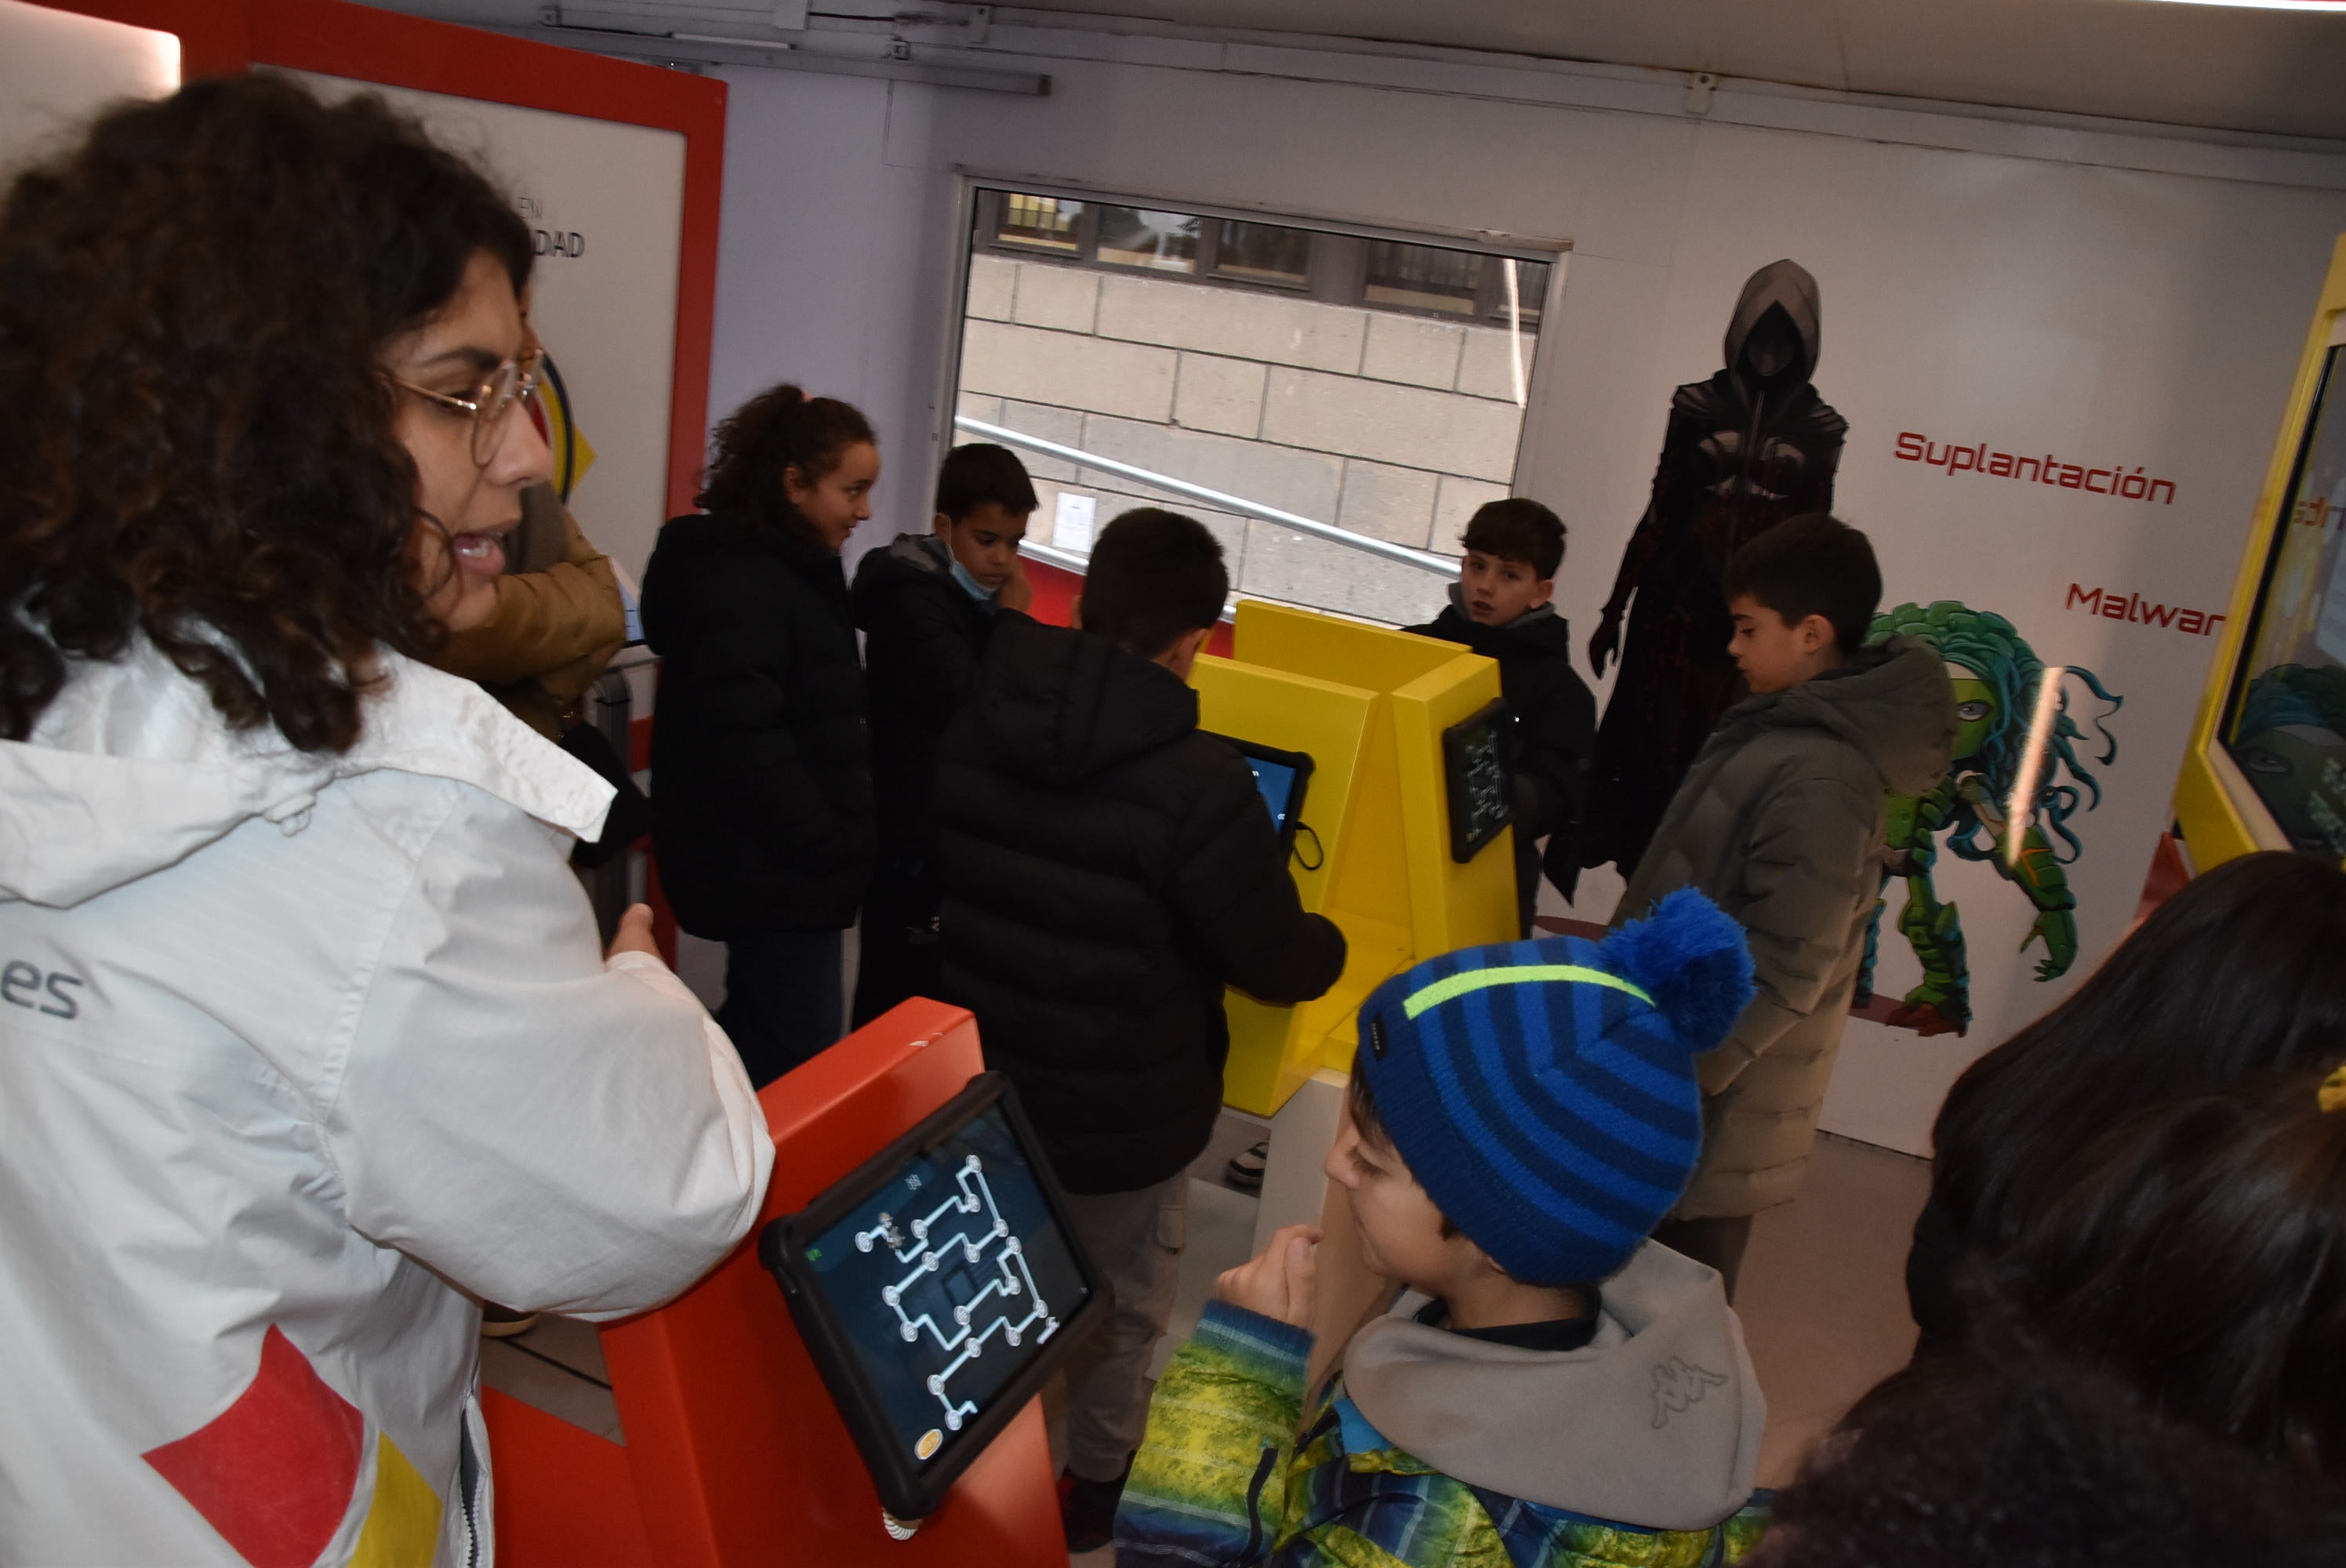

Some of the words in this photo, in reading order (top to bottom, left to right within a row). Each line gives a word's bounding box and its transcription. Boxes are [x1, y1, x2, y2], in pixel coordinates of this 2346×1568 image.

[1894, 431, 2177, 505] Suplantación
[2064, 583, 2227, 637] Malwar
[1, 959, 84, 1020] es
